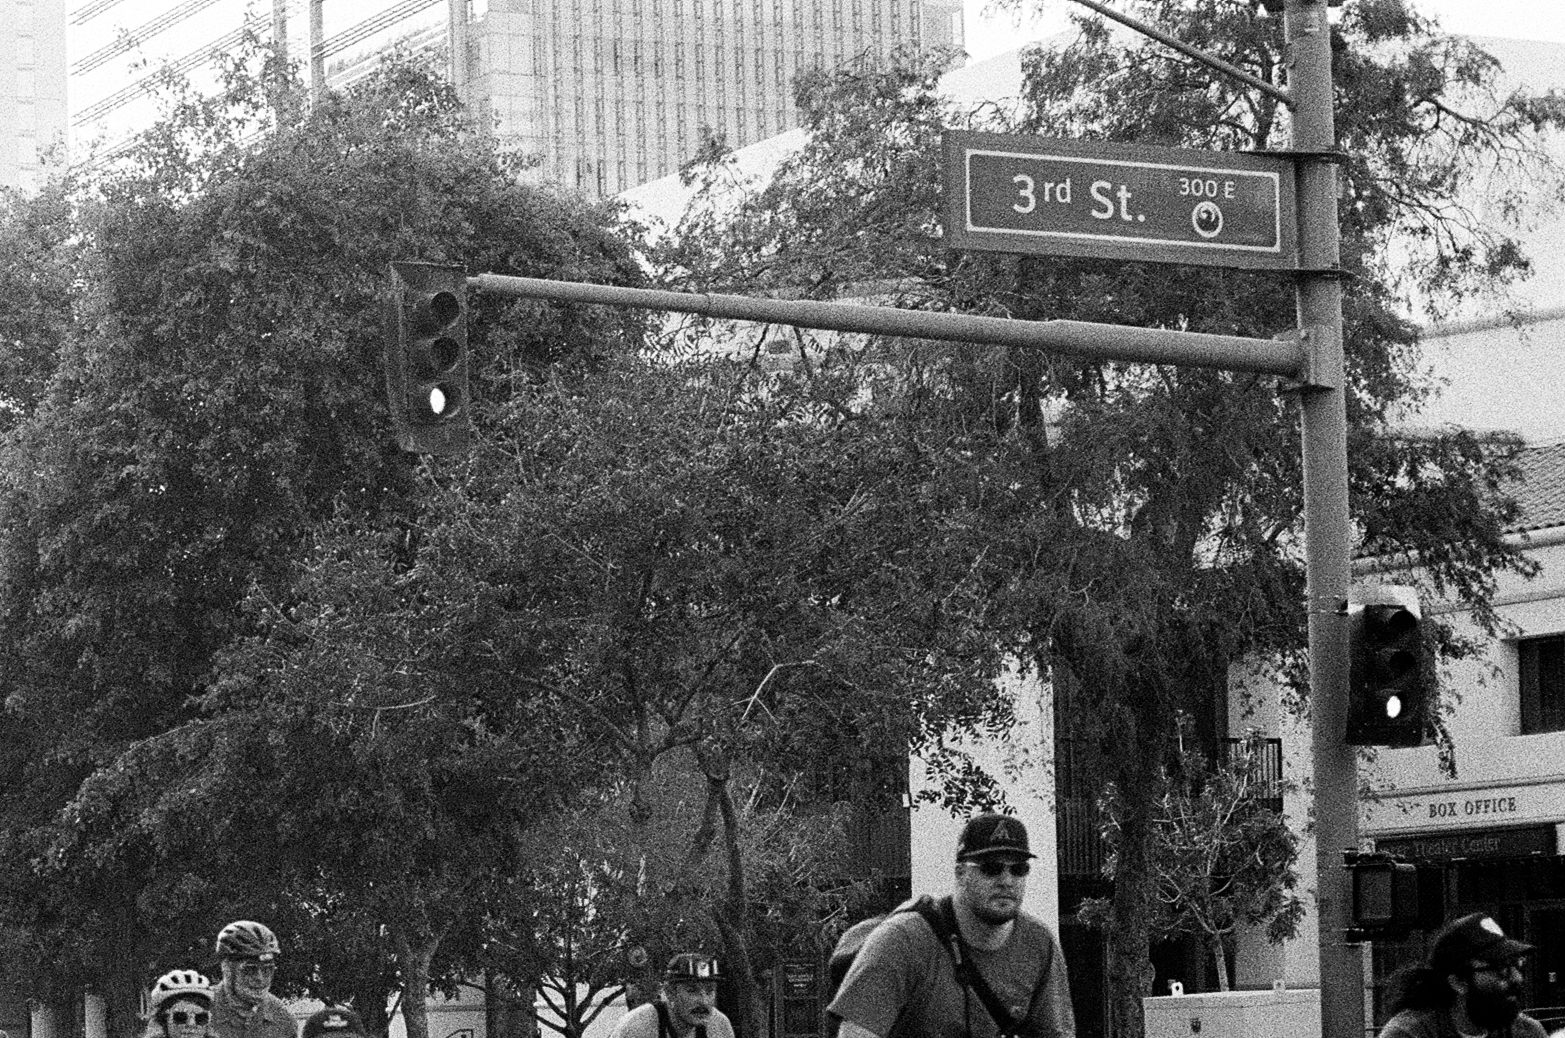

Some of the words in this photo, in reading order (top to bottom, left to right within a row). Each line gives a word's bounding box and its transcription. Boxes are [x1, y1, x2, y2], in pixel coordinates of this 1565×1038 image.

[1012, 174, 1072, 214] 3rd
[1090, 180, 1146, 222] St.
[1179, 177, 1218, 198] 300
[1224, 181, 1235, 199] E
[1429, 801, 1457, 818] BOX
[1465, 797, 1516, 815] OFFICE
